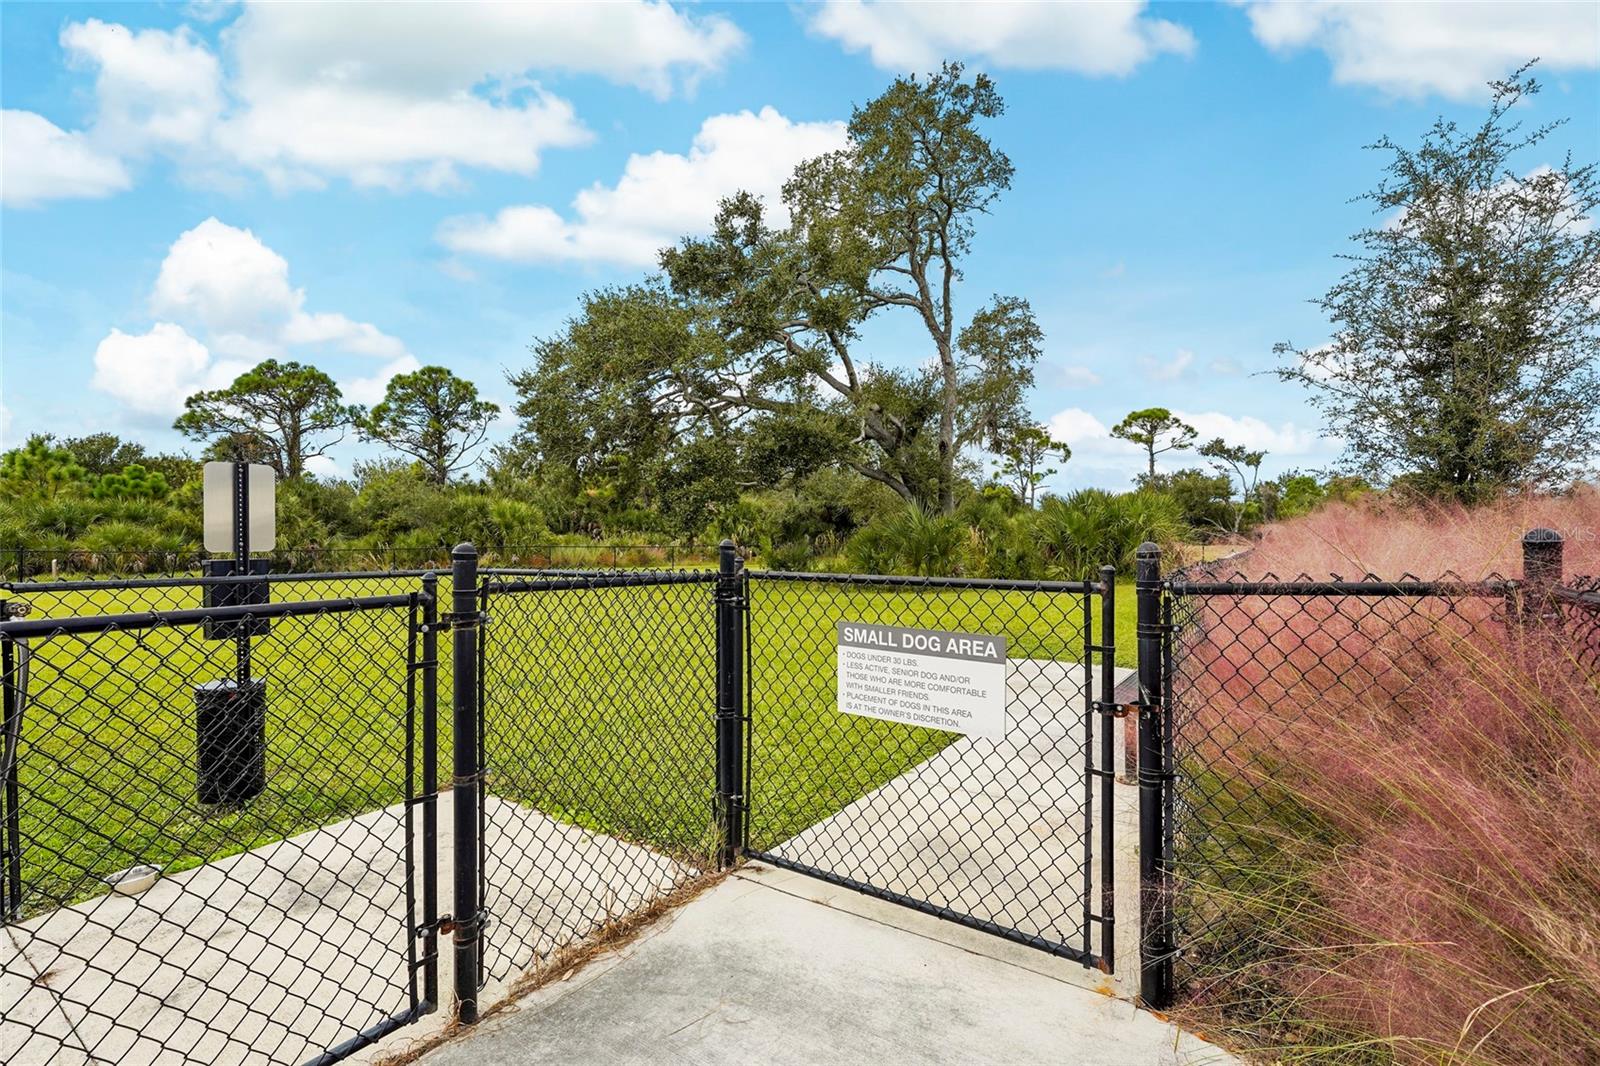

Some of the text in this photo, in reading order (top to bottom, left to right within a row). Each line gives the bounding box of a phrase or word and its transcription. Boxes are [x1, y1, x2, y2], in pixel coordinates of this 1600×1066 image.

[844, 627, 998, 658] SMALL DOG AREA
[847, 651, 866, 660] DOGS
[868, 654, 891, 664] UNDER
[903, 658, 918, 667] LBS.
[847, 662, 969, 684] LESS ACTIVE, SENIOR DOG AND/OR
[846, 682, 929, 700] WITH SMALLER FRIENDS.
[847, 672, 986, 698] THOSE WHO ARE MORE COMFORTABLE
[847, 692, 886, 704] PLACEMENT
[900, 700, 920, 709] DOGS
[933, 705, 950, 714] THIS
[951, 708, 972, 718] AREA
[864, 705, 877, 713] THE
[878, 707, 911, 719] OWNER'S
[914, 712, 960, 727] DISCRETION.
